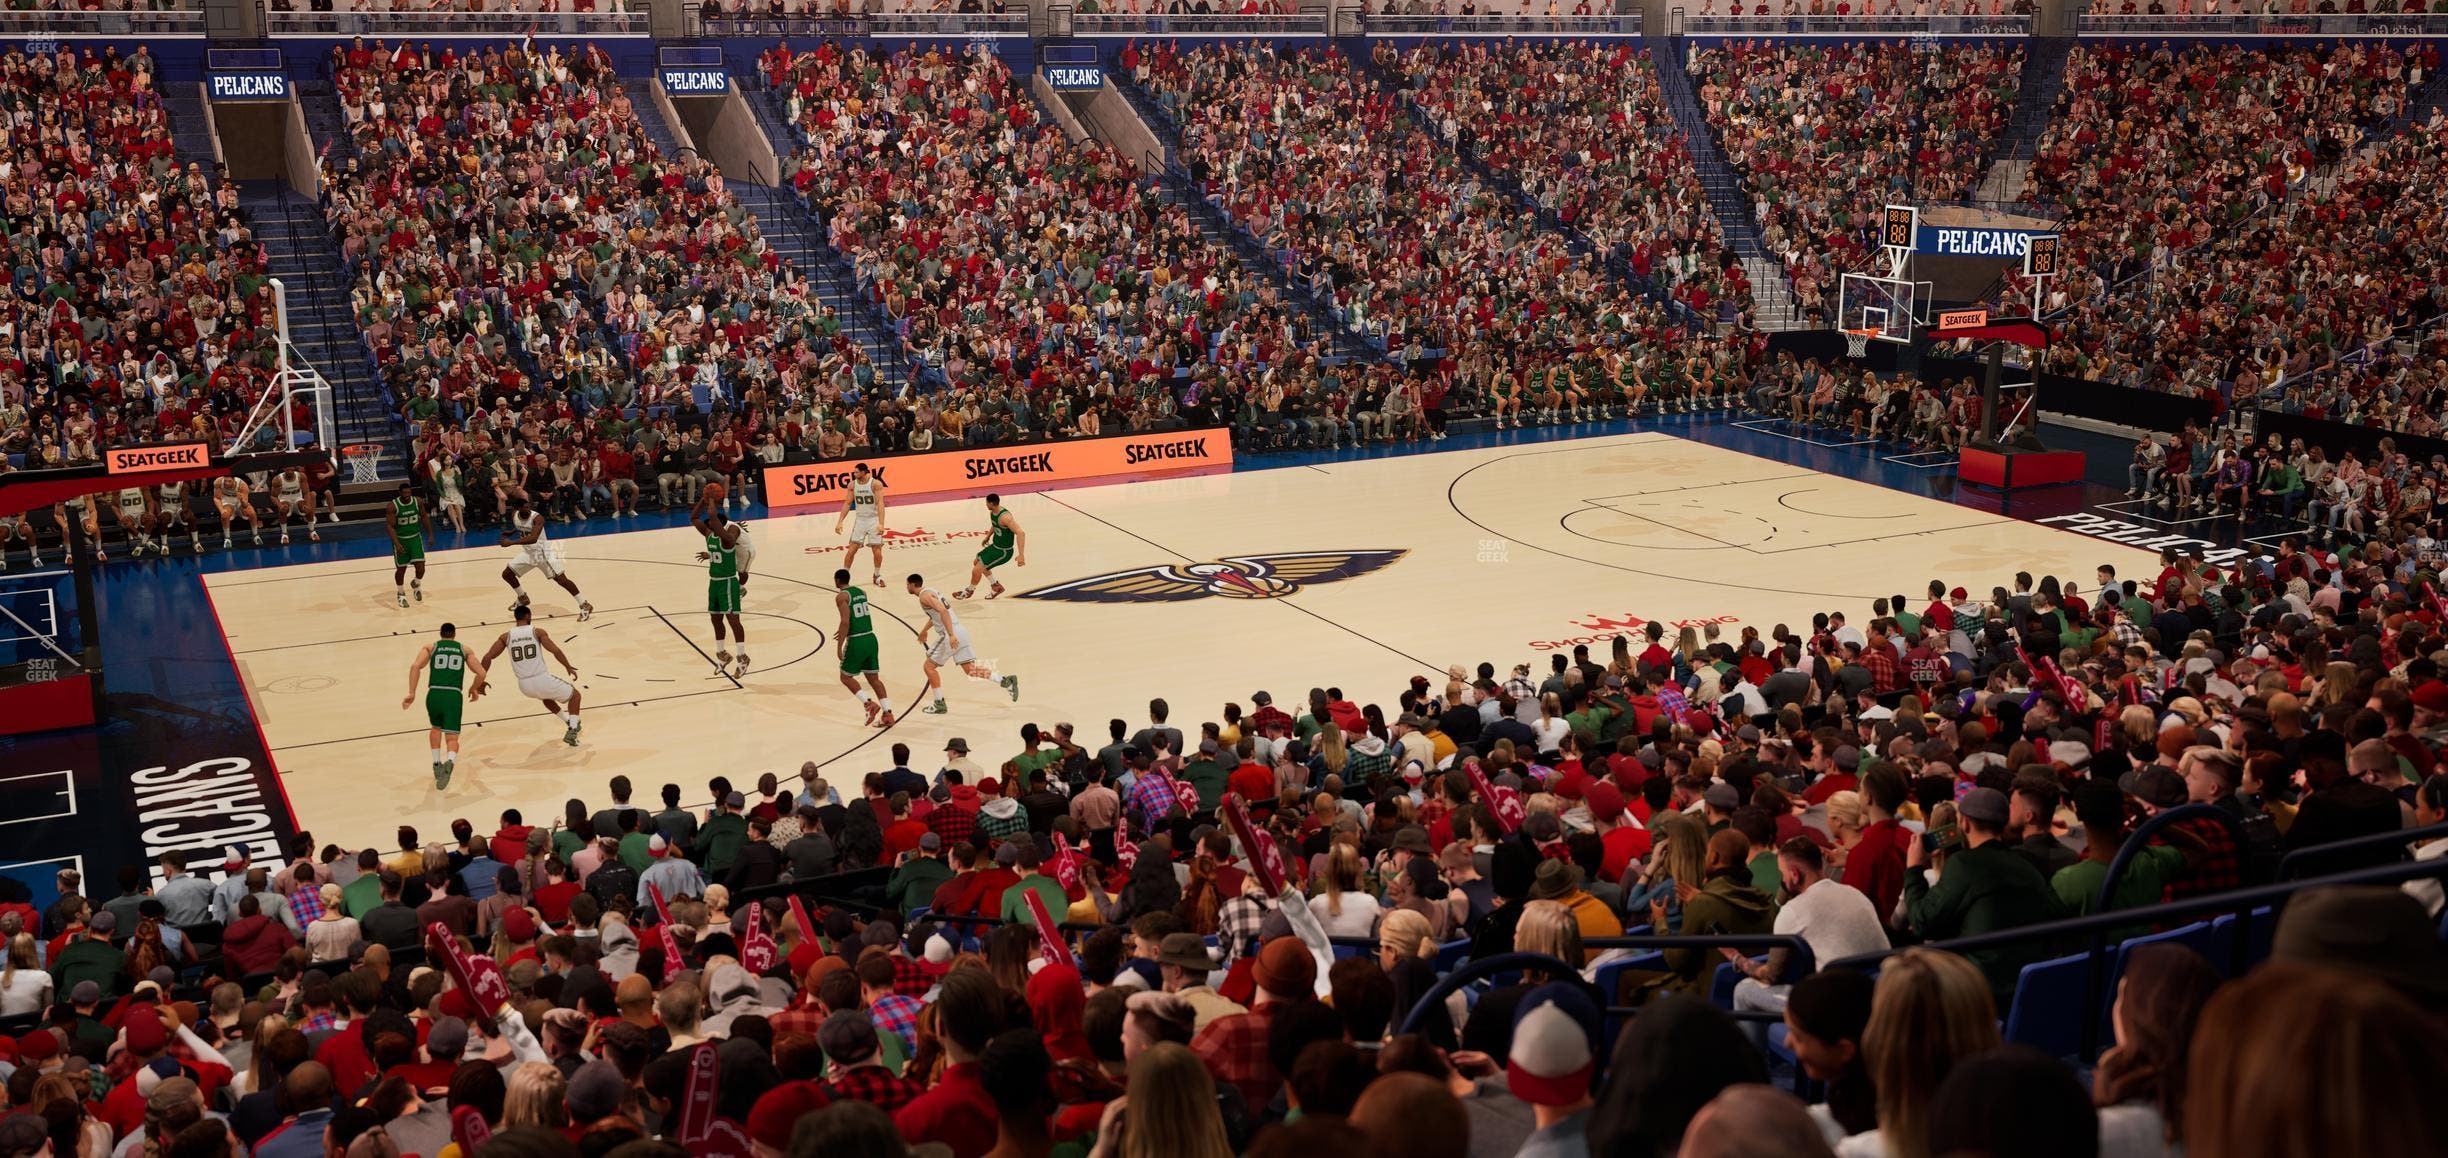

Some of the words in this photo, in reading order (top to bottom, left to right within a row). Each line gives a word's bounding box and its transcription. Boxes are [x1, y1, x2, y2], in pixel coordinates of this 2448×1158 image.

[214, 76, 284, 95] PELICANS
[665, 72, 725, 90] PELICANS
[1050, 69, 1099, 85] PELICANS
[1937, 229, 2029, 256] PELICANS
[1945, 313, 1981, 326] SEATGEEK
[117, 448, 199, 469] SEATGEEK
[1125, 437, 1208, 464] SEATGEEK
[965, 451, 1053, 479] SEATGEEK
[793, 466, 888, 495] SEATGK
[804, 535, 938, 555] SMTHIE
[434, 654, 463, 670] 00
[511, 644, 537, 662] 00
